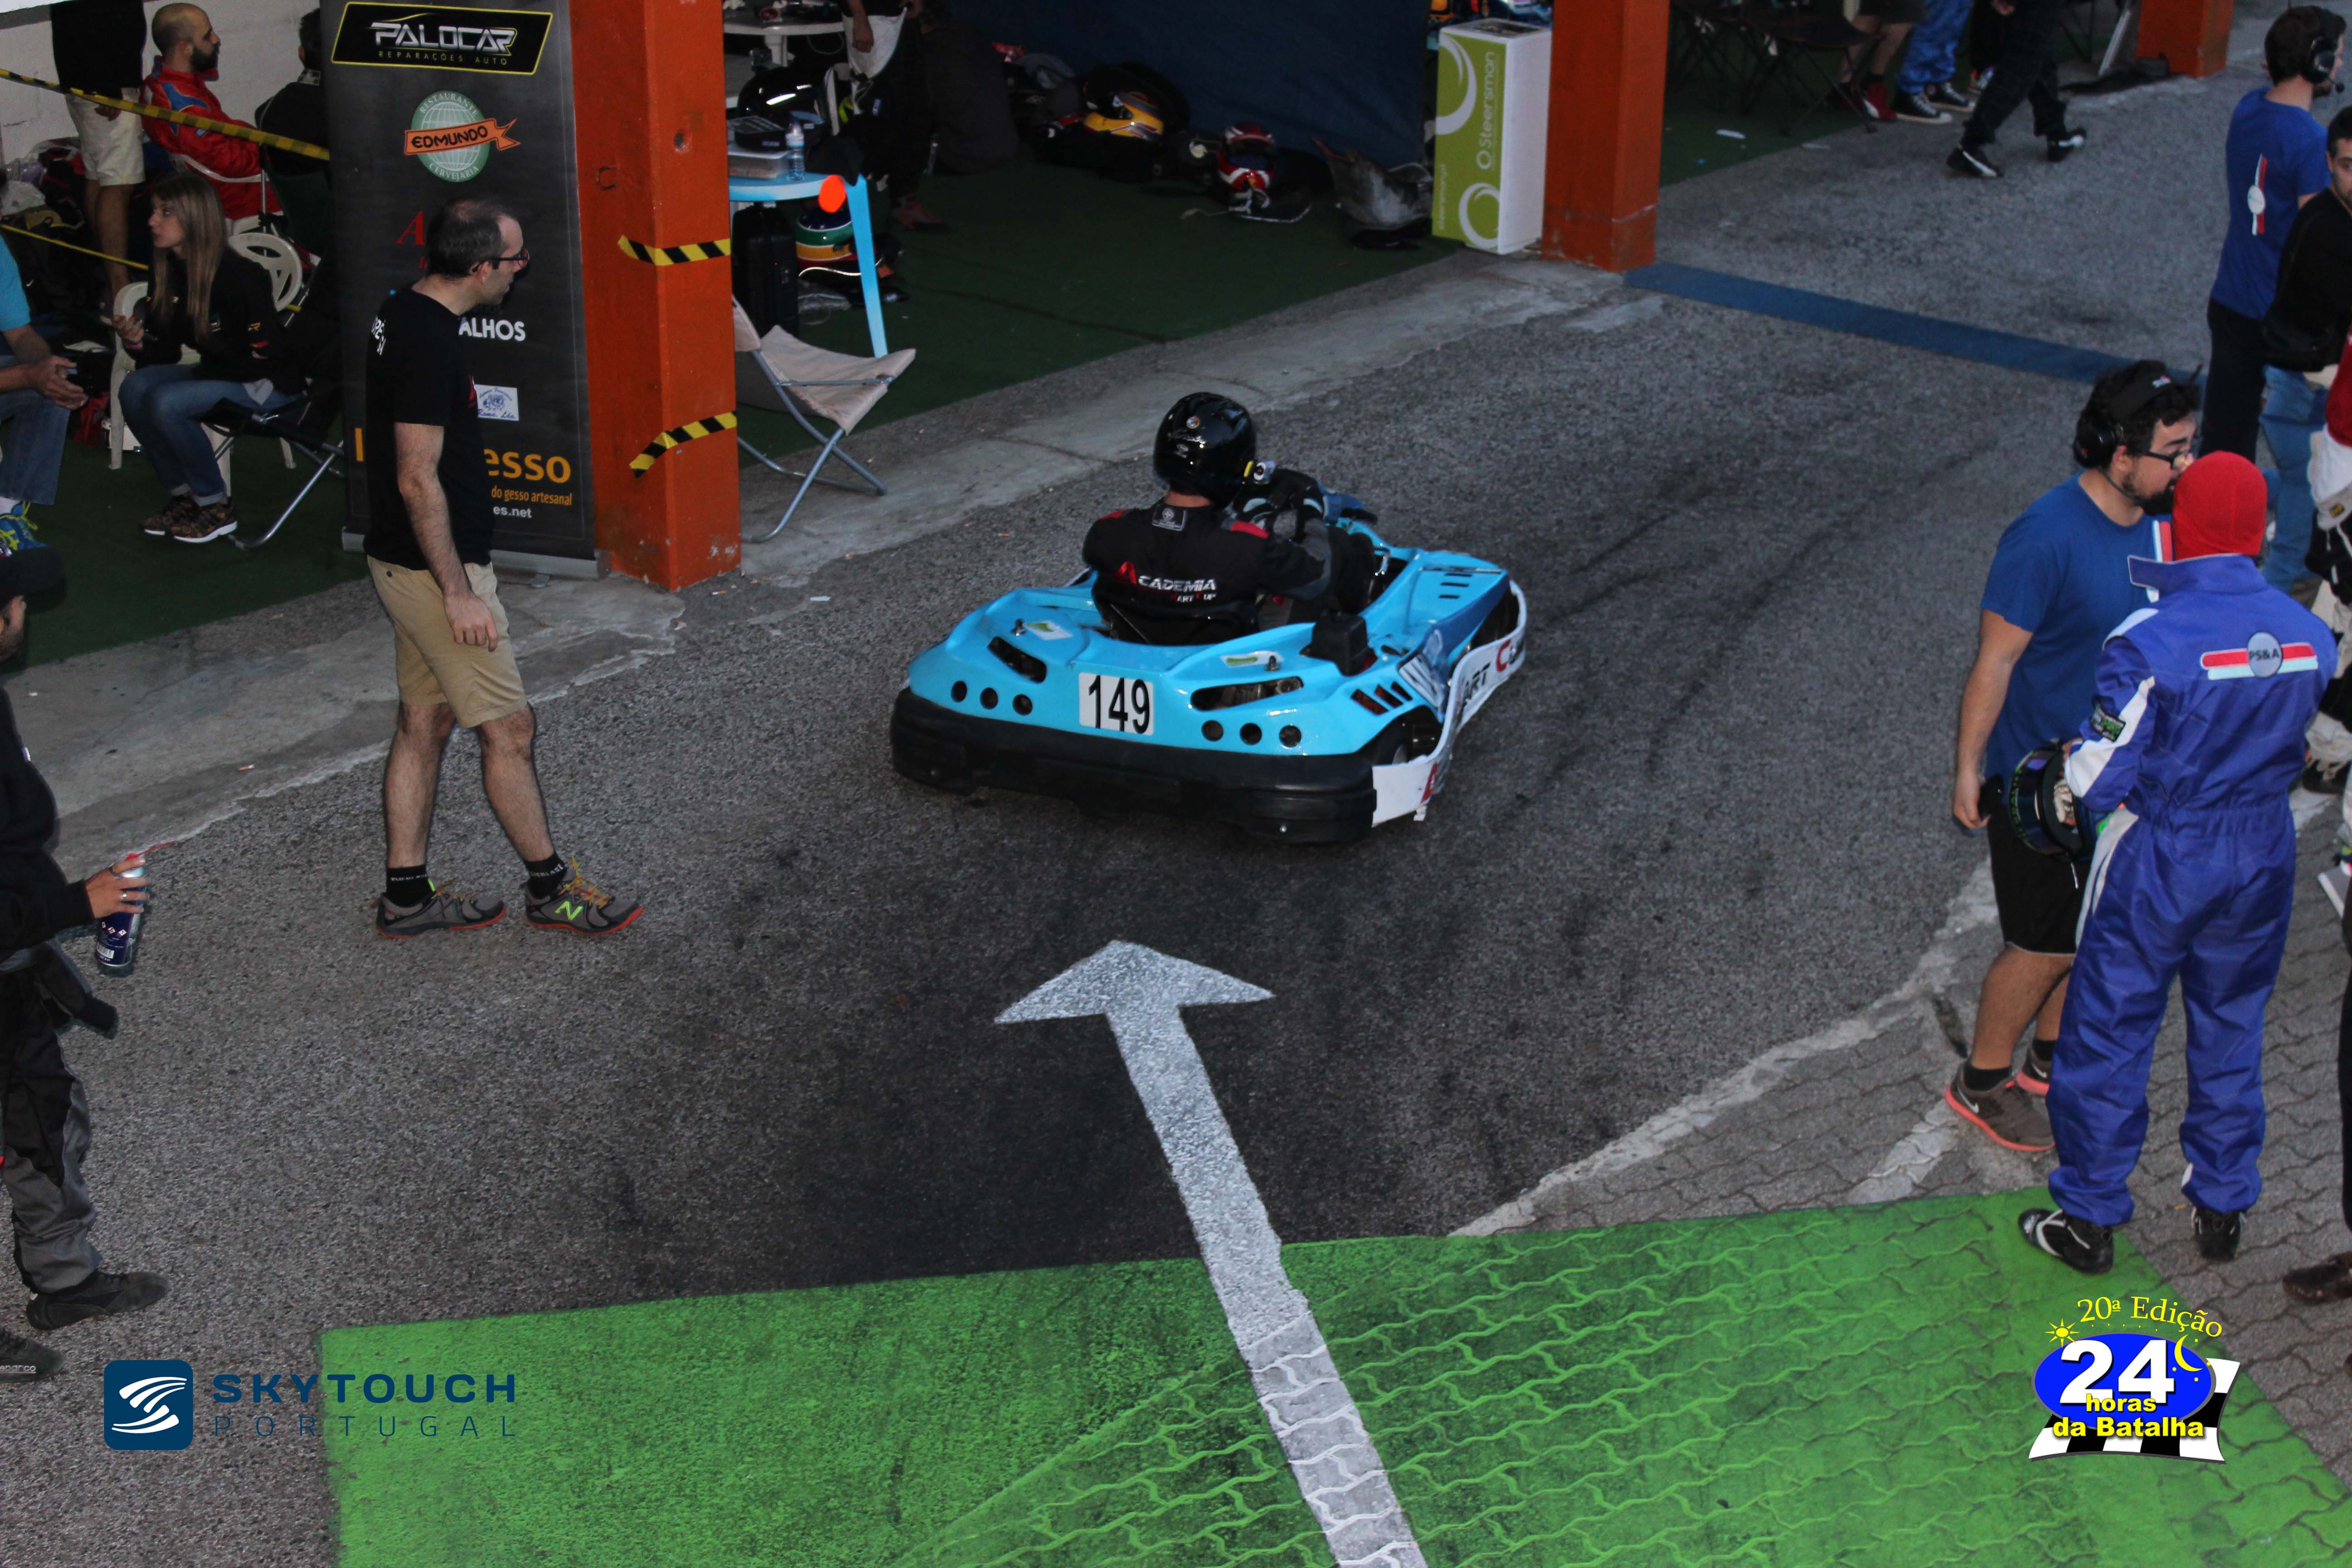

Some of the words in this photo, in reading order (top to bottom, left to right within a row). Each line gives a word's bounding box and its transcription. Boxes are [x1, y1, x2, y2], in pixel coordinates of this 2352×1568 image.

[371, 22, 516, 53] PALOCAR
[378, 50, 463, 62] REPARAÇÕES
[475, 57, 507, 65] AUTO
[420, 92, 477, 116] RESTAURANTE
[411, 125, 488, 148] EDMUNDO
[429, 163, 479, 181] CERVEJARIA
[504, 488, 529, 502] gesso
[531, 492, 573, 506] artesanal
[1114, 561, 1217, 592] ACADEMIA
[2249, 648, 2280, 661] PS&A
[1088, 675, 1150, 734] 149
[0, 1364, 36, 1372] sparco
